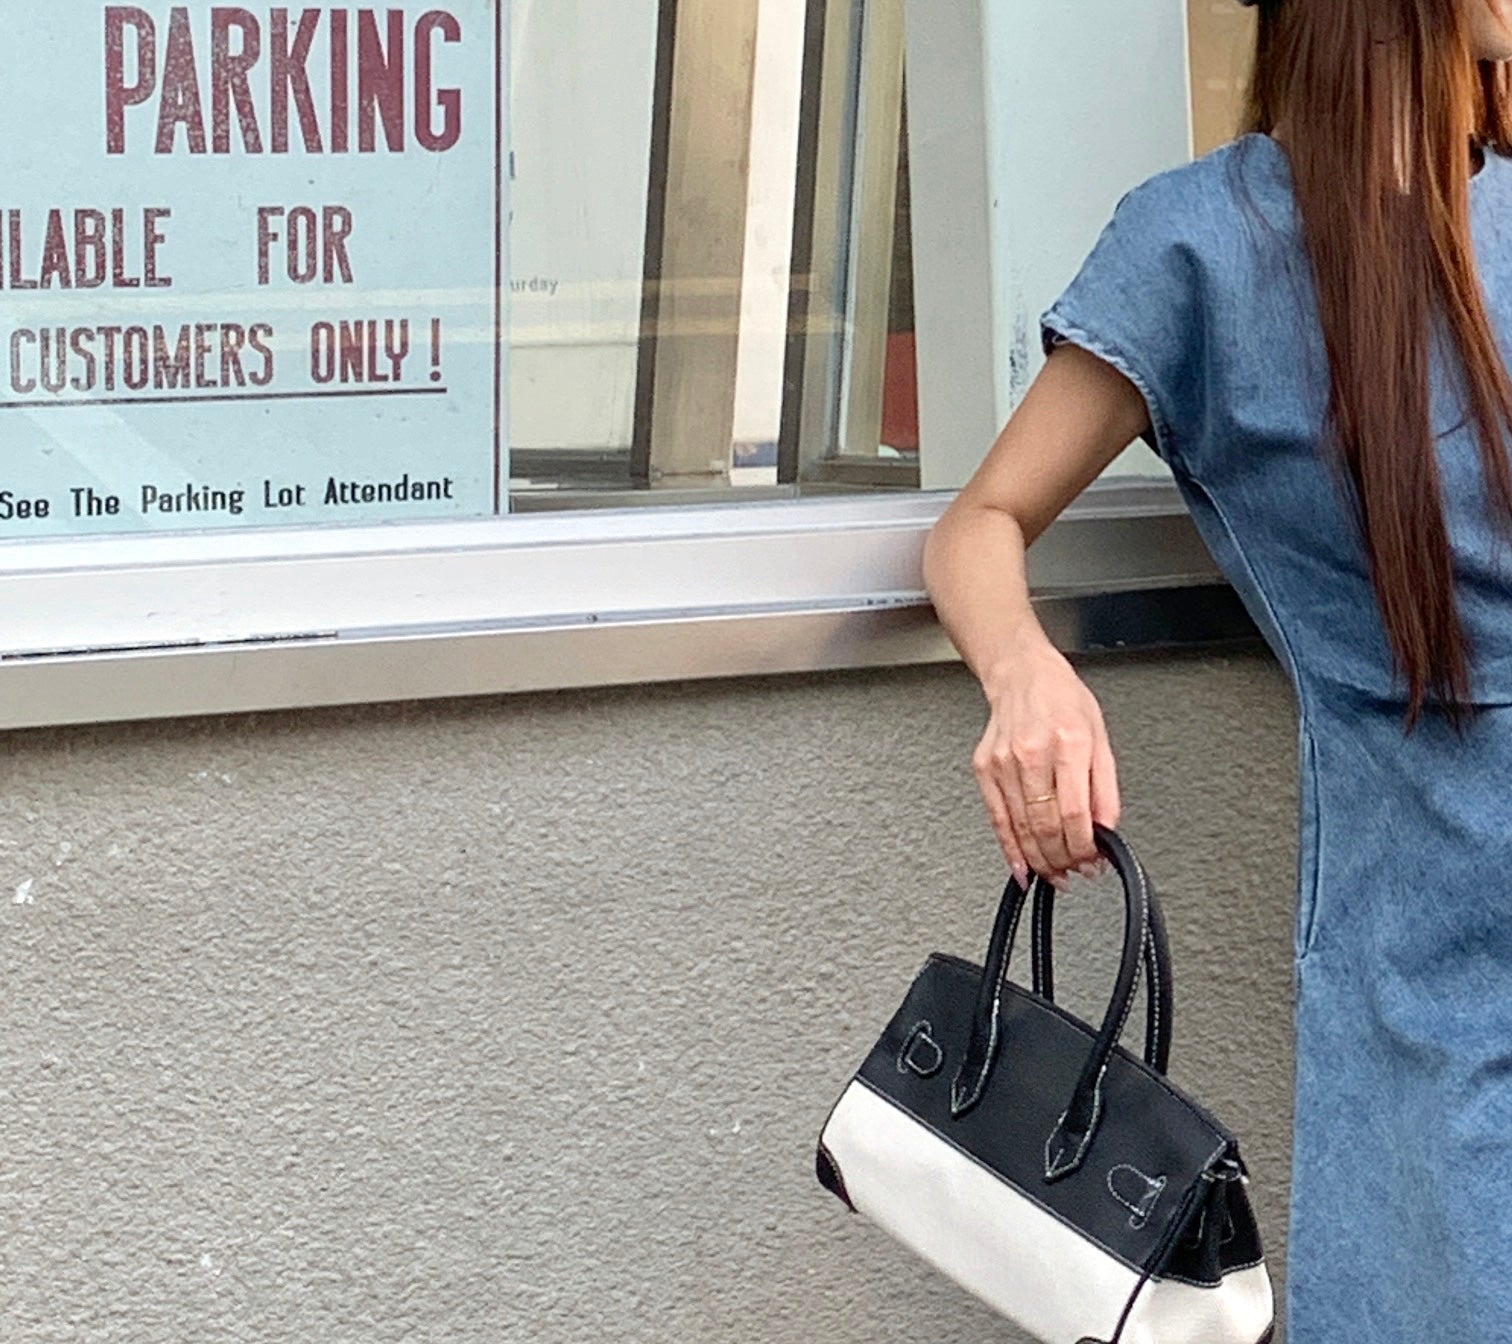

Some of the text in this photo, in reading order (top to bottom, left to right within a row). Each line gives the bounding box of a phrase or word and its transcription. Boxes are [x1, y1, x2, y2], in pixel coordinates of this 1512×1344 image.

[104, 4, 462, 155] PARKING
[257, 205, 354, 285] FOR
[9, 322, 274, 394] CUSTOMERS
[0, 474, 454, 520] See The Parking Lot Attendant
